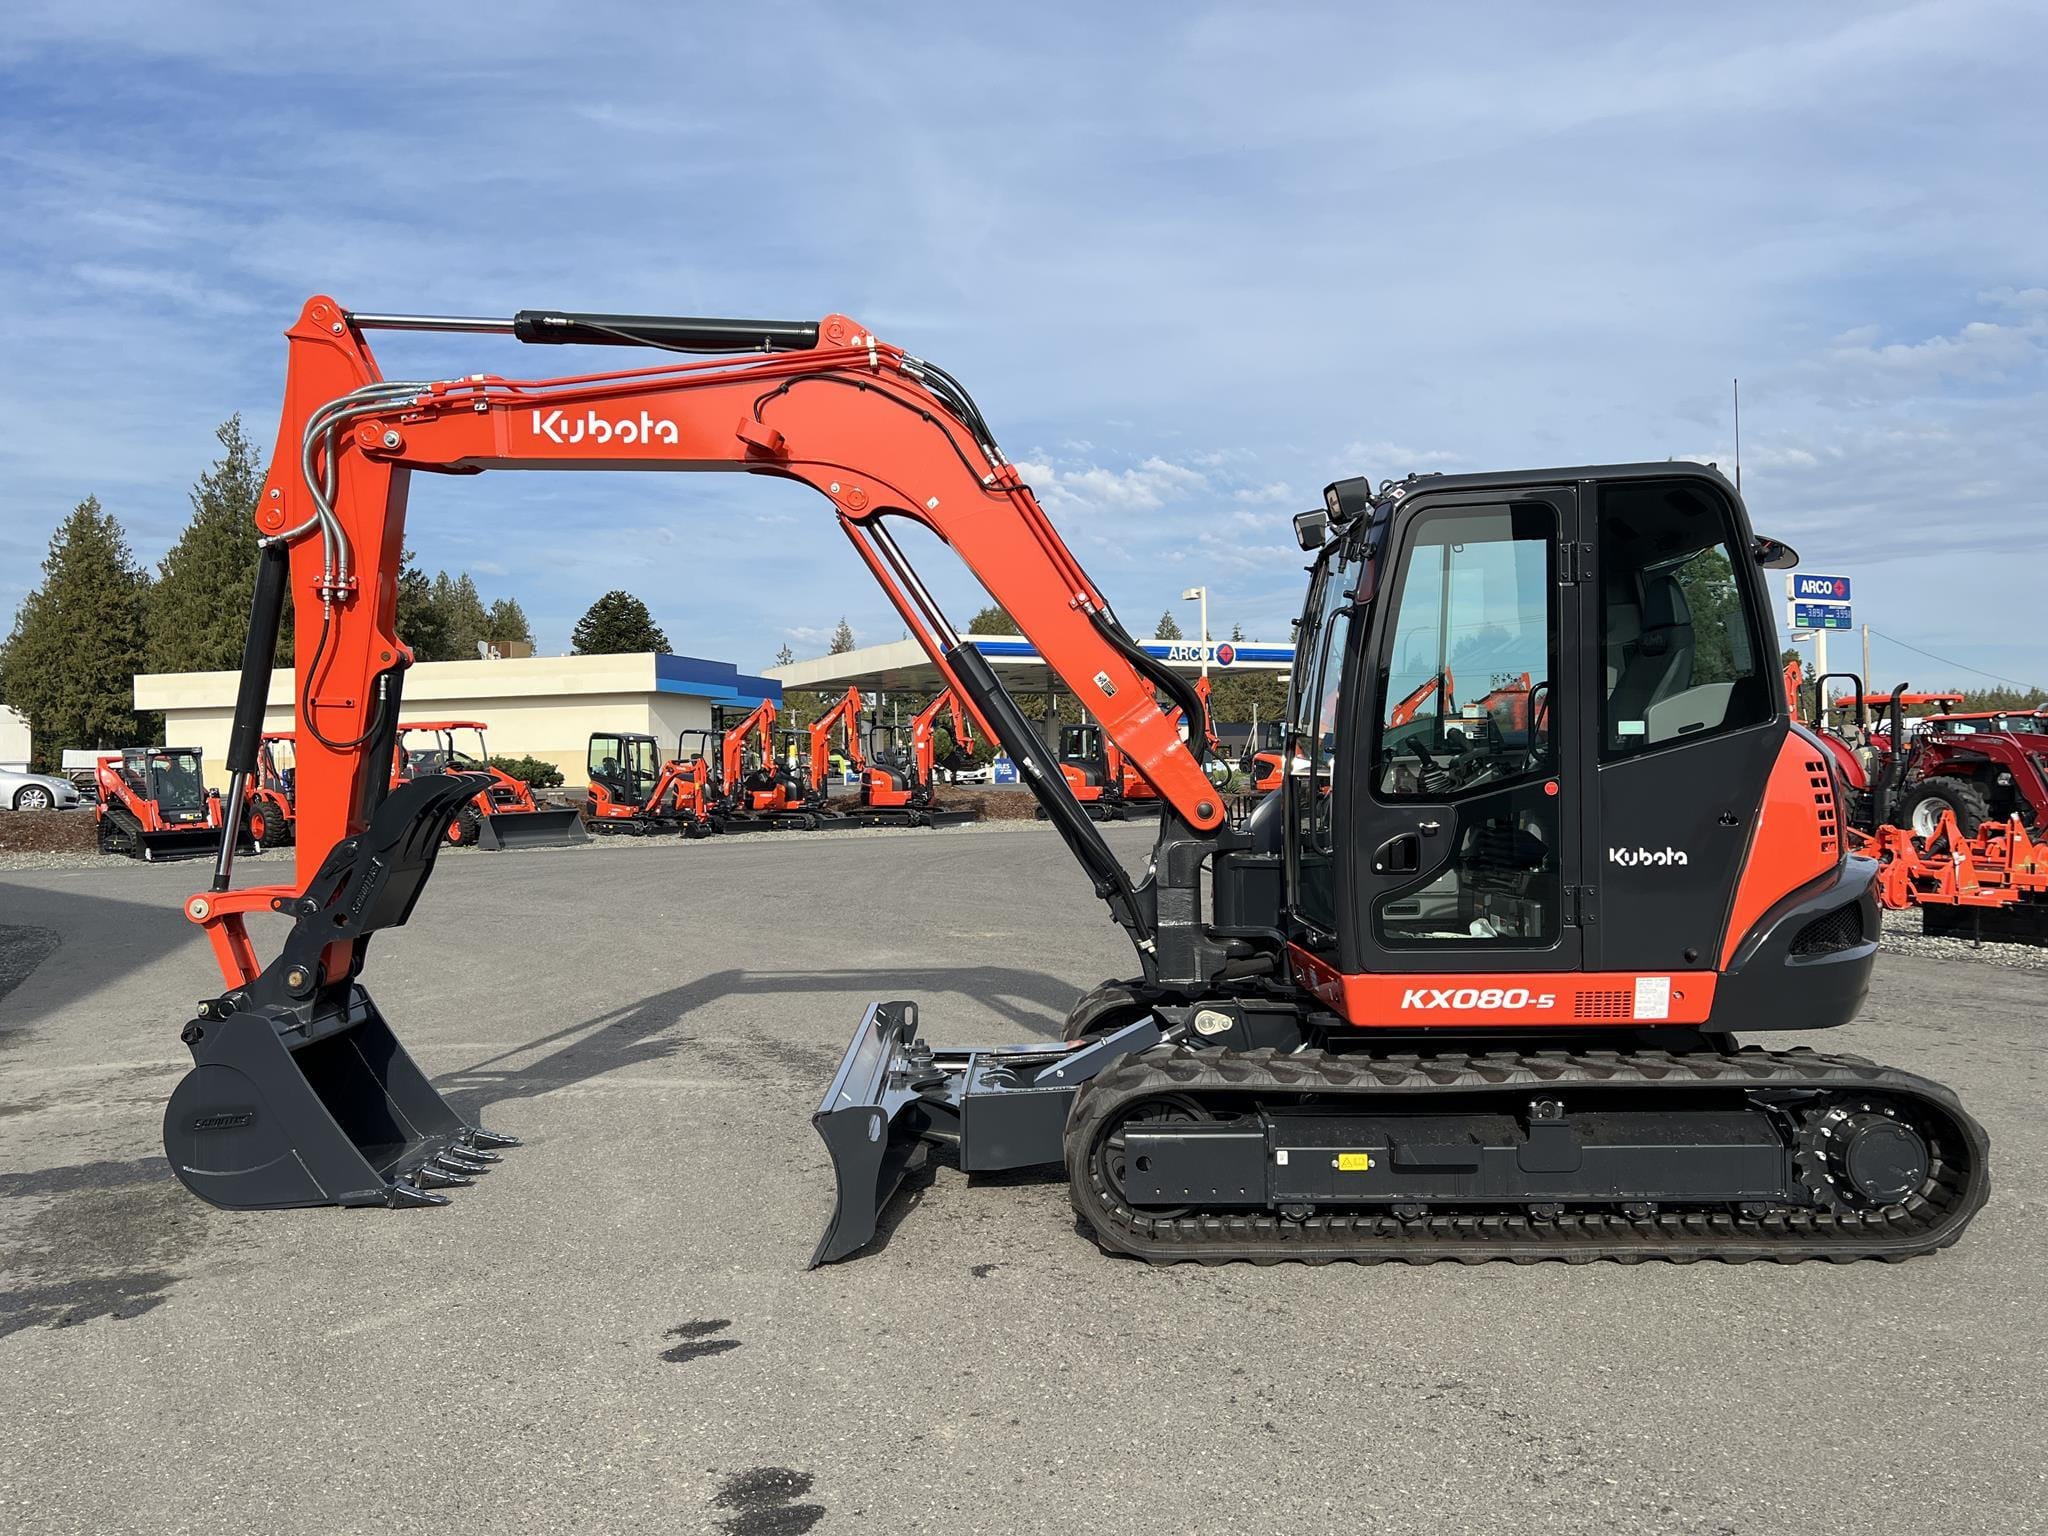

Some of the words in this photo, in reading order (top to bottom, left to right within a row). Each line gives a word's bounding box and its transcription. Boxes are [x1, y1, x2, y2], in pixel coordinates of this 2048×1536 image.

[533, 410, 679, 444] Kubota
[1801, 580, 1832, 595] ARCO
[1168, 647, 1210, 661] ARCO
[1609, 847, 1688, 866] Kubota
[1400, 988, 1556, 1009] KX080-5
